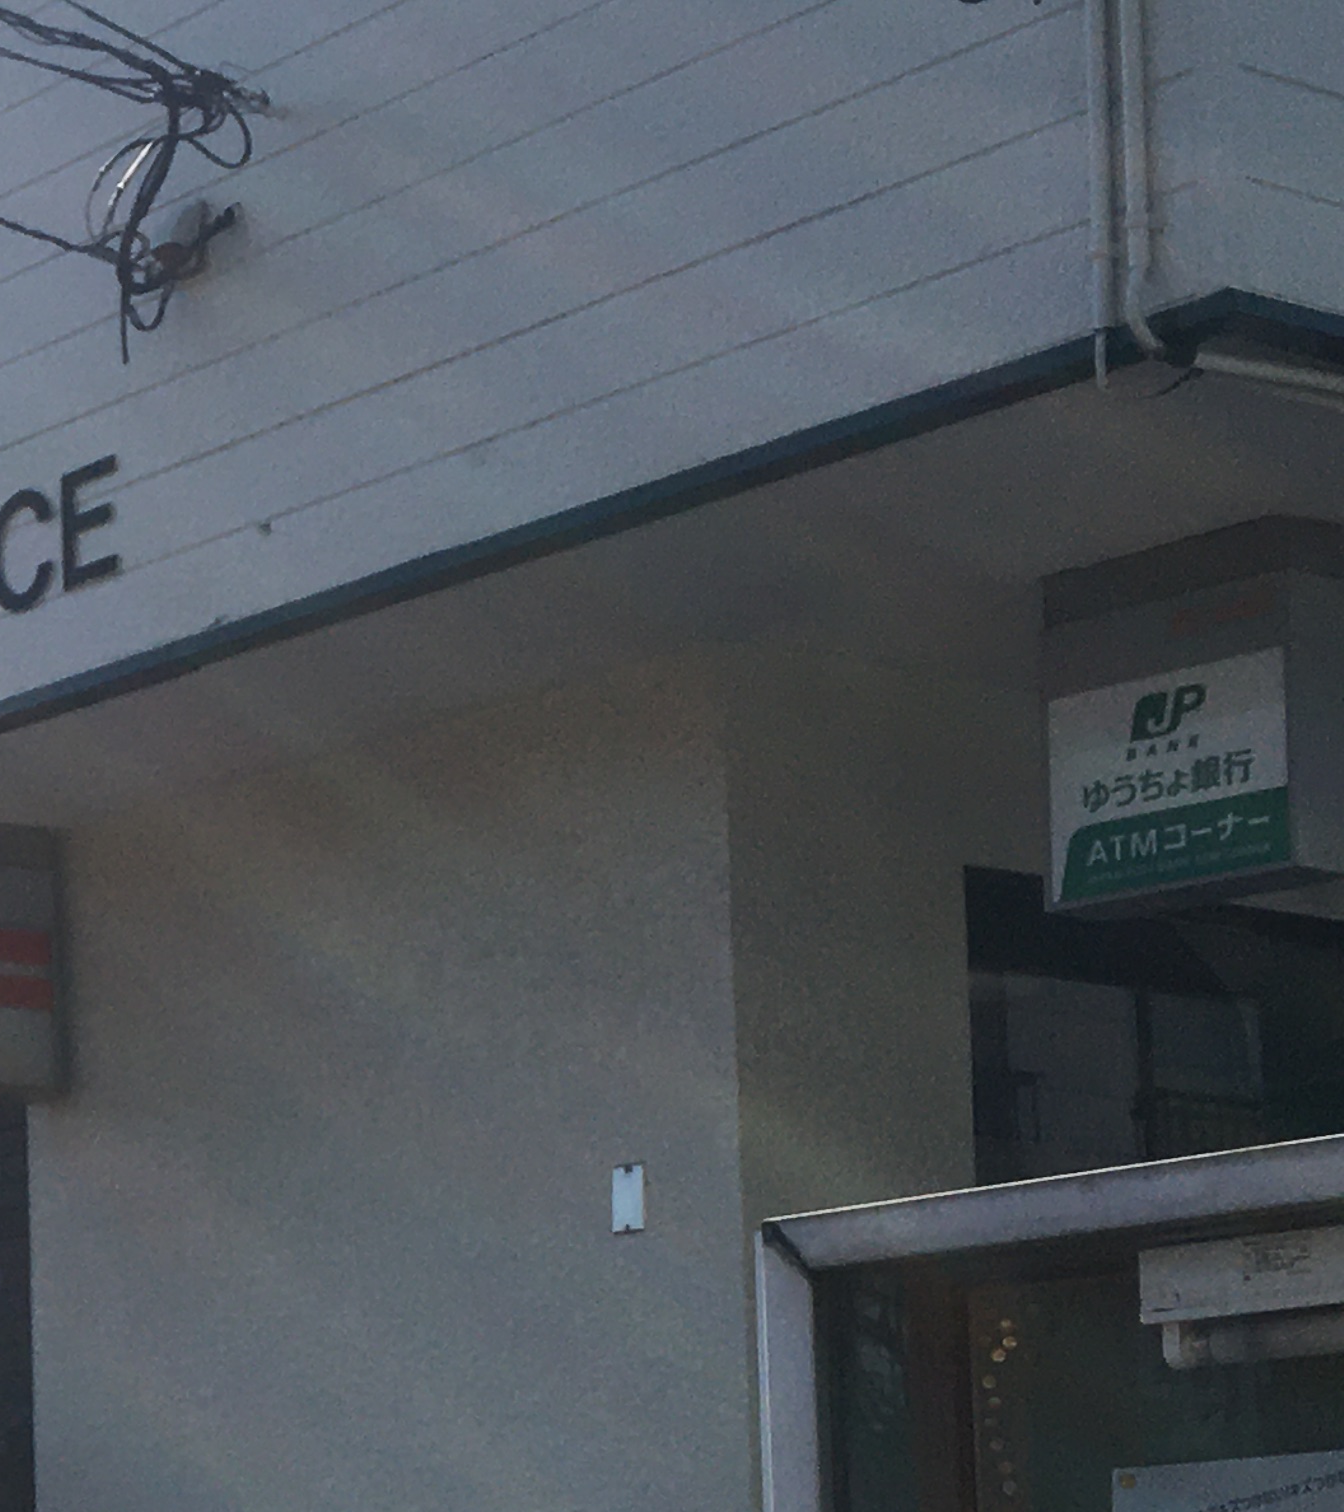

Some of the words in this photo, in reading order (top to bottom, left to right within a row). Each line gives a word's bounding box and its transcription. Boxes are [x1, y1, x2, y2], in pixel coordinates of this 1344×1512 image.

[1082, 748, 1255, 812] ゆうちょ銀行
[1087, 812, 1270, 866] ATMコーナー
